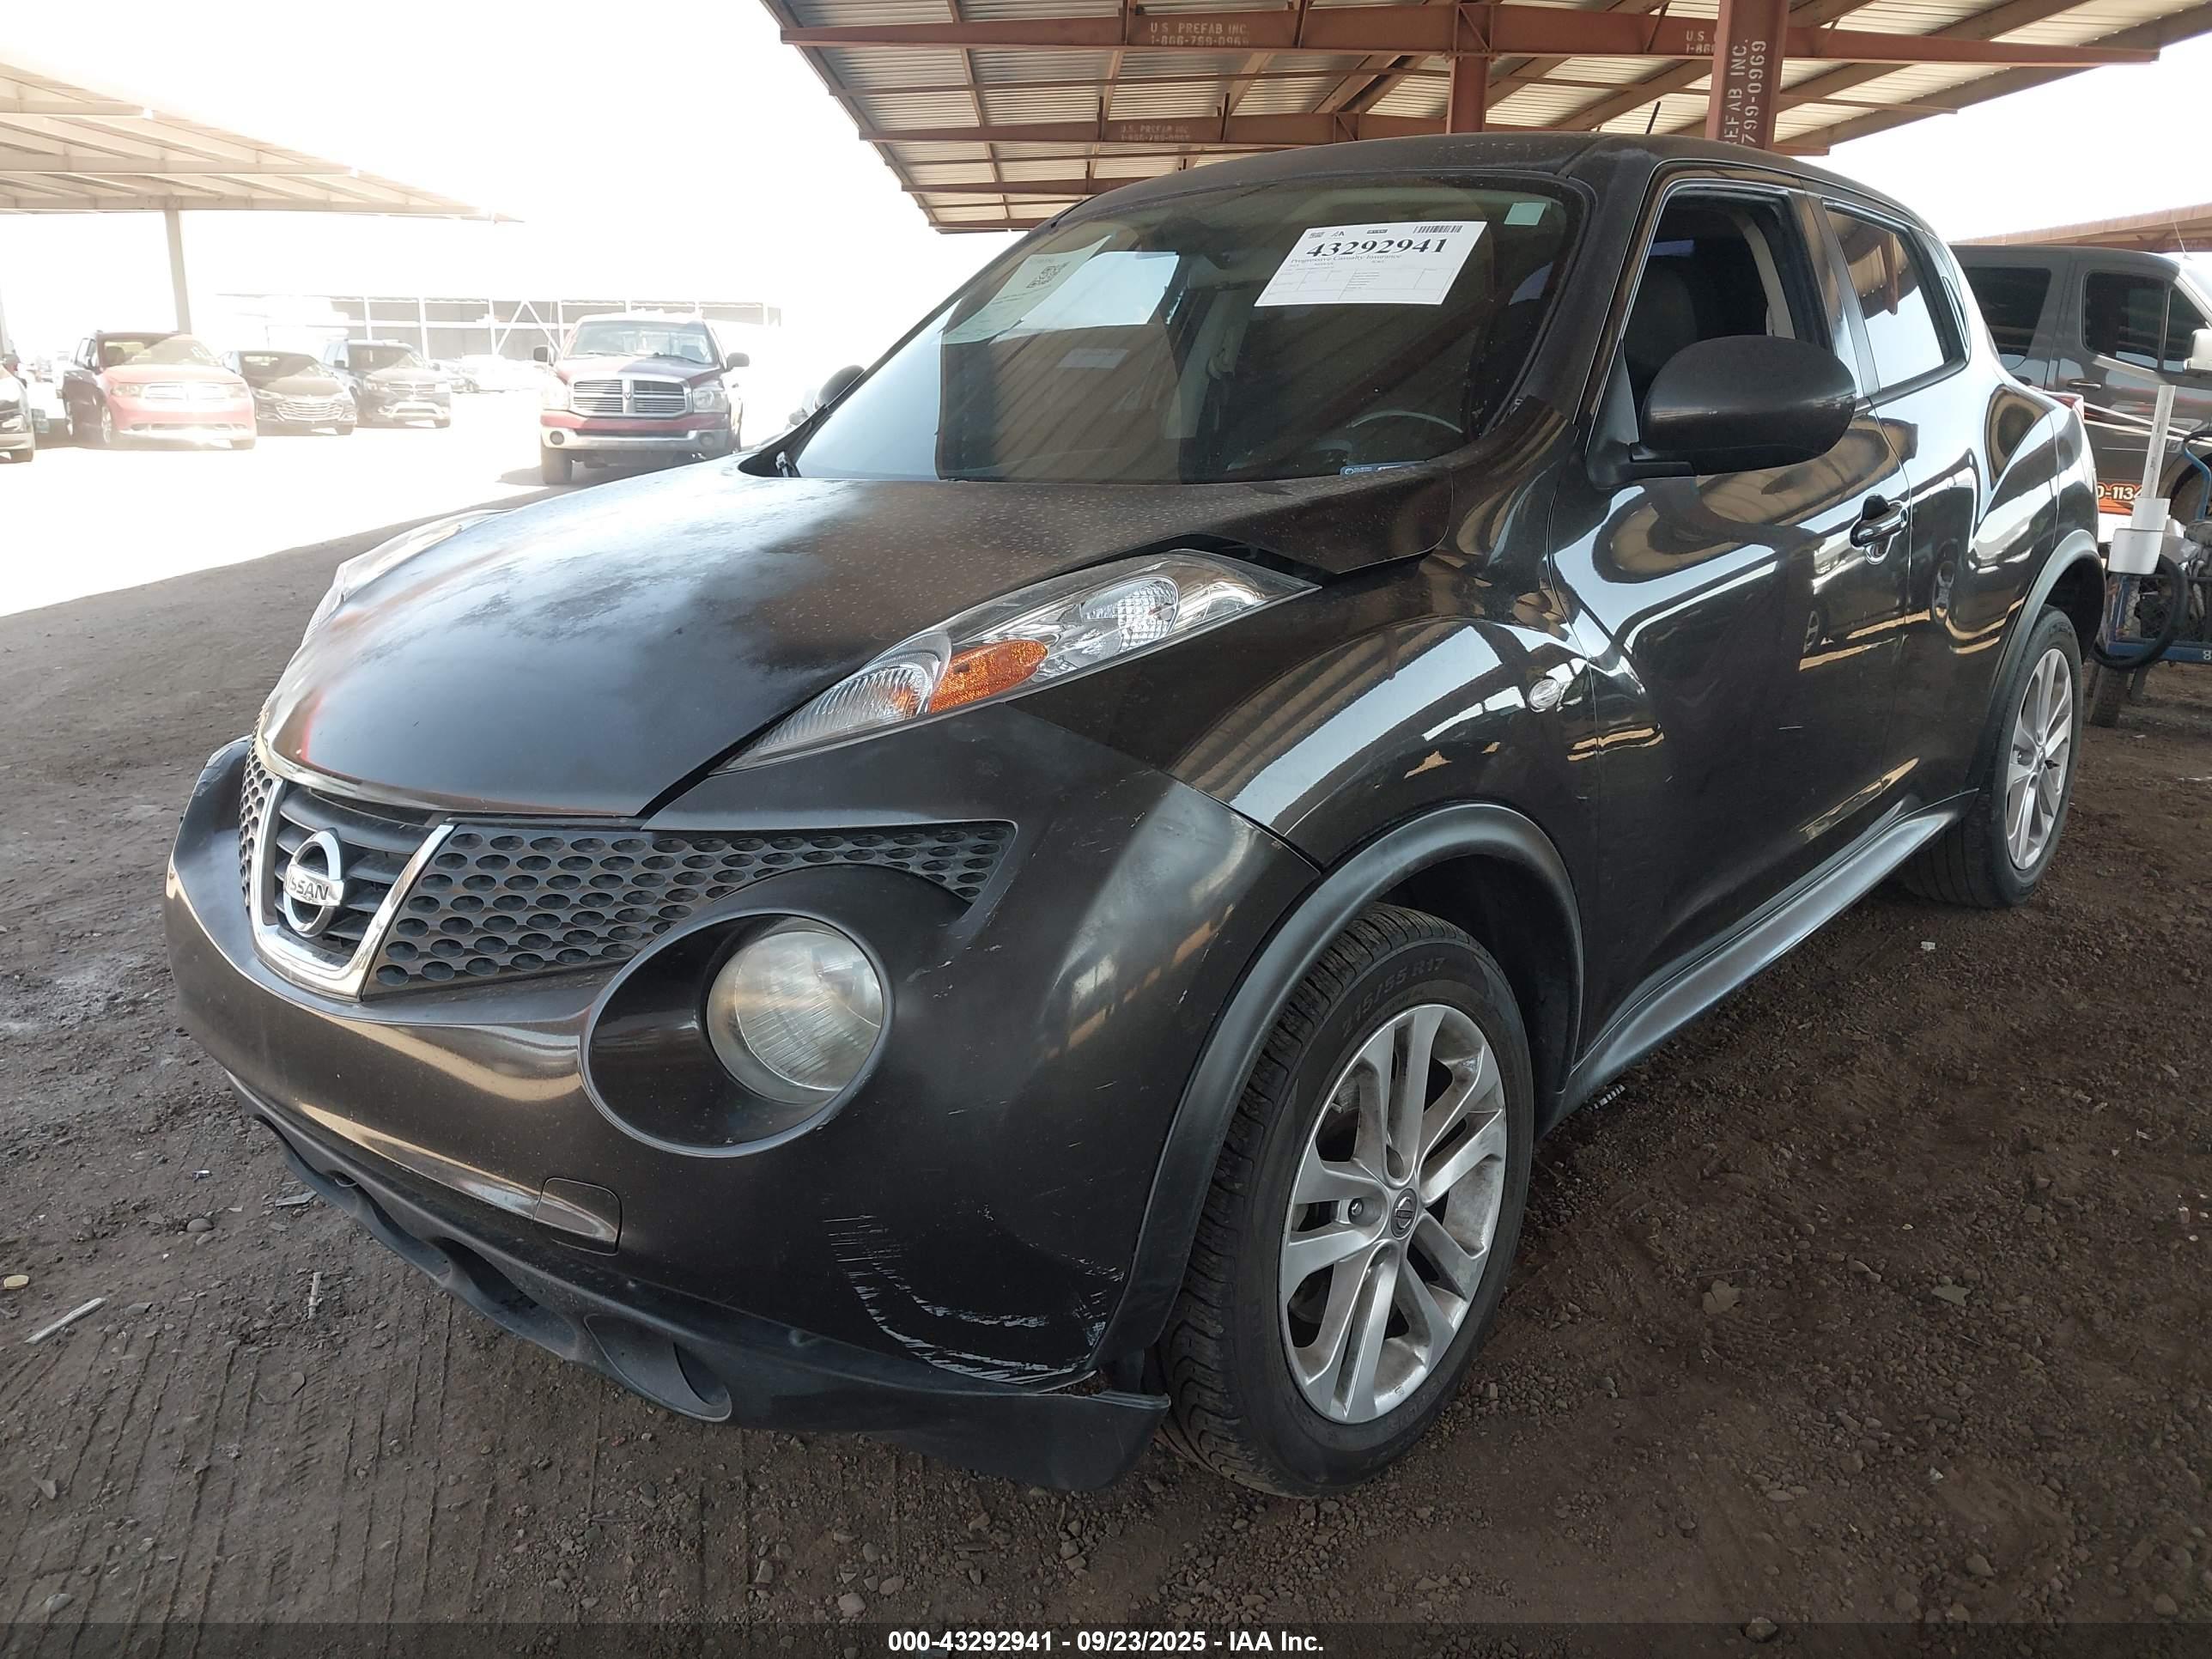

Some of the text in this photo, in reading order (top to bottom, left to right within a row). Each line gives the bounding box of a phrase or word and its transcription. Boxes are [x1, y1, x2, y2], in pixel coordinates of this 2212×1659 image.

[1178, 22, 1224, 34] PREFAB
[1730, 39, 1747, 76] INC.
[1305, 239, 1449, 258] 43292941
[284, 872, 330, 901] NISSAN
